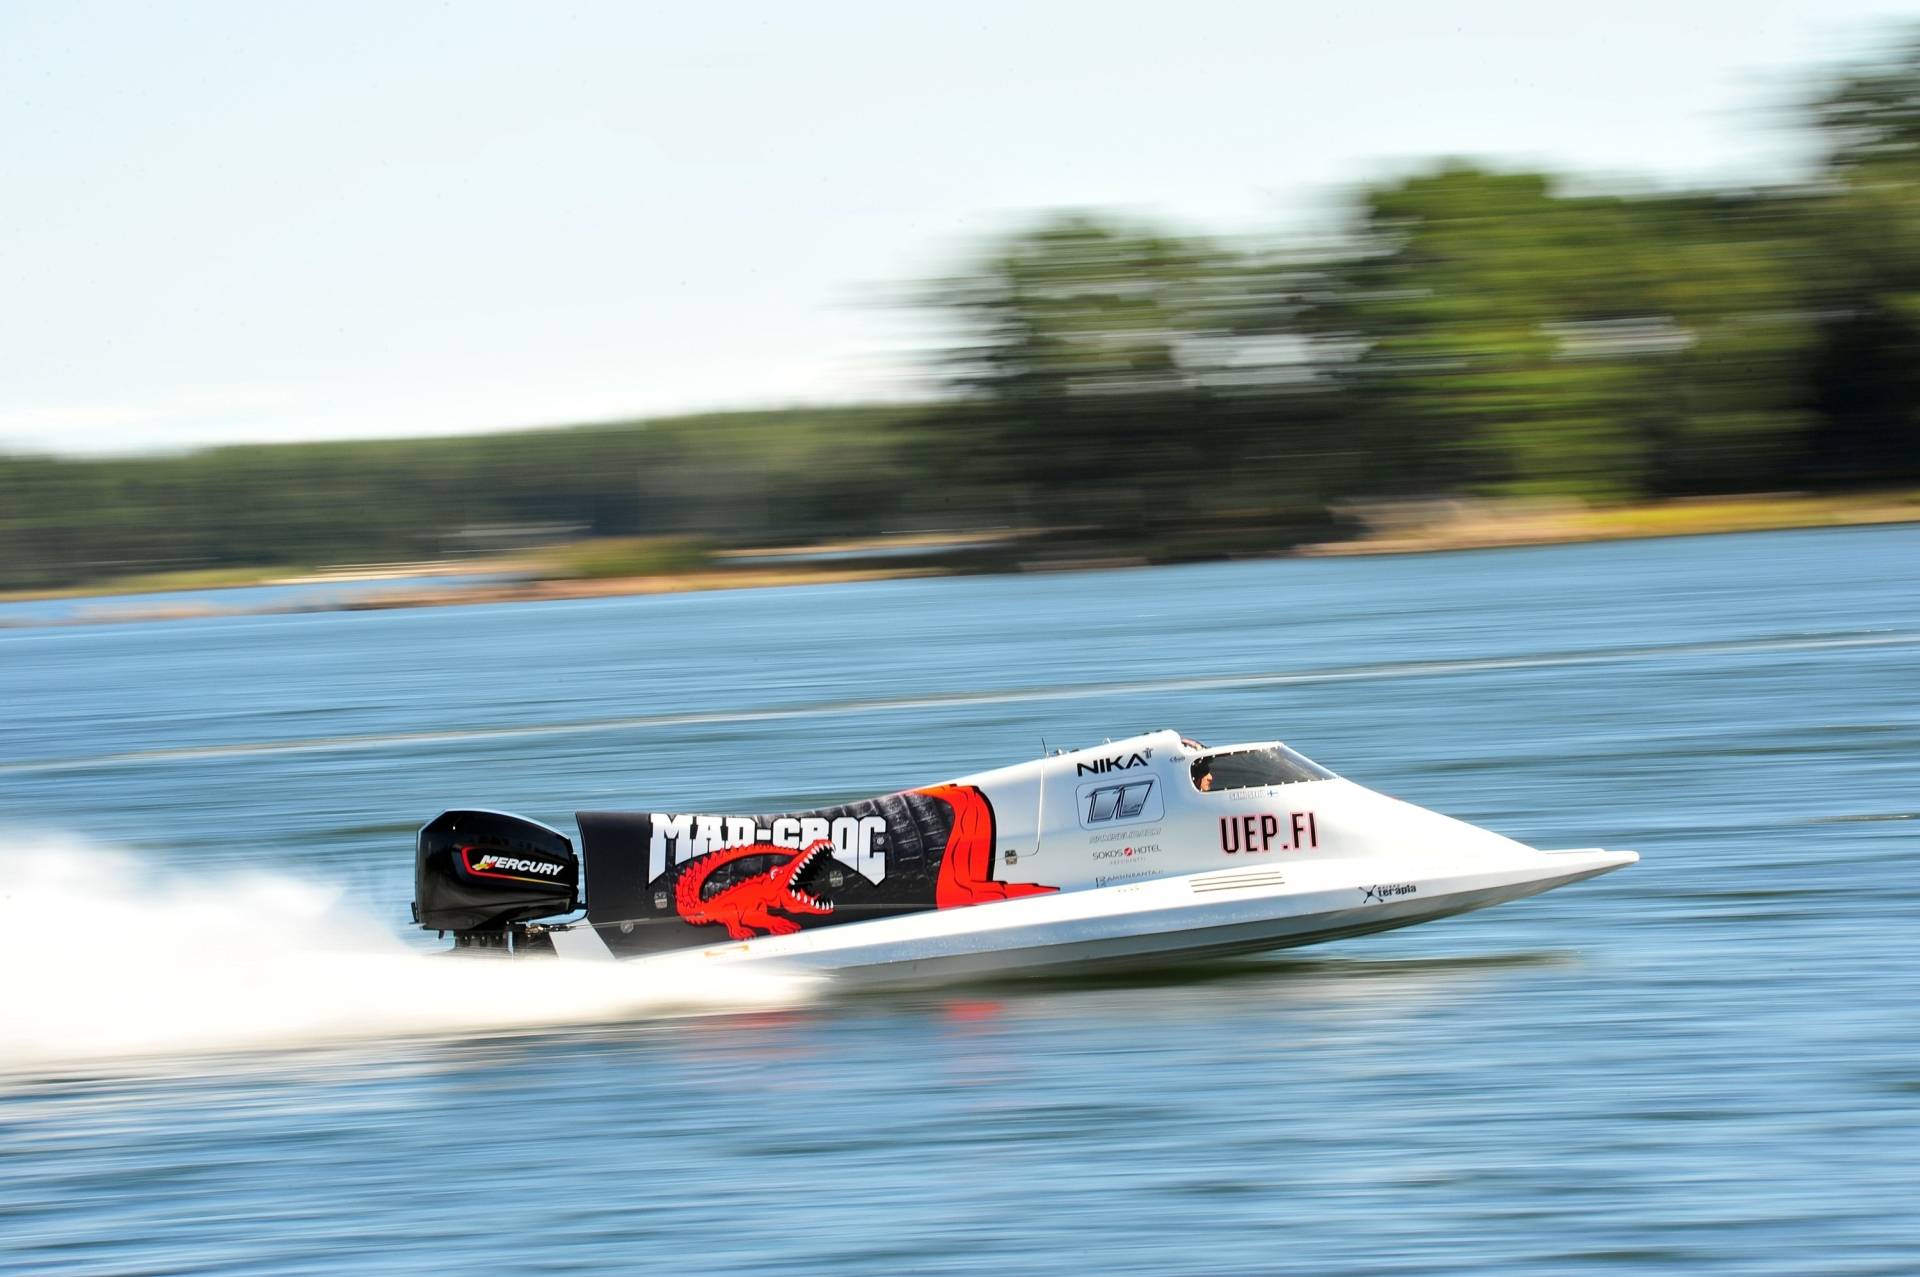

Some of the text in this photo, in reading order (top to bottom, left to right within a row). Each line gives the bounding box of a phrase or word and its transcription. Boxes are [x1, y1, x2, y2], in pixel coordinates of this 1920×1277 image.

[1077, 753, 1148, 777] NIKA
[1220, 811, 1318, 855] UEP.FI
[1092, 847, 1124, 861] SOKOS
[1133, 844, 1162, 855] HOTEL
[475, 854, 565, 876] MERCURY
